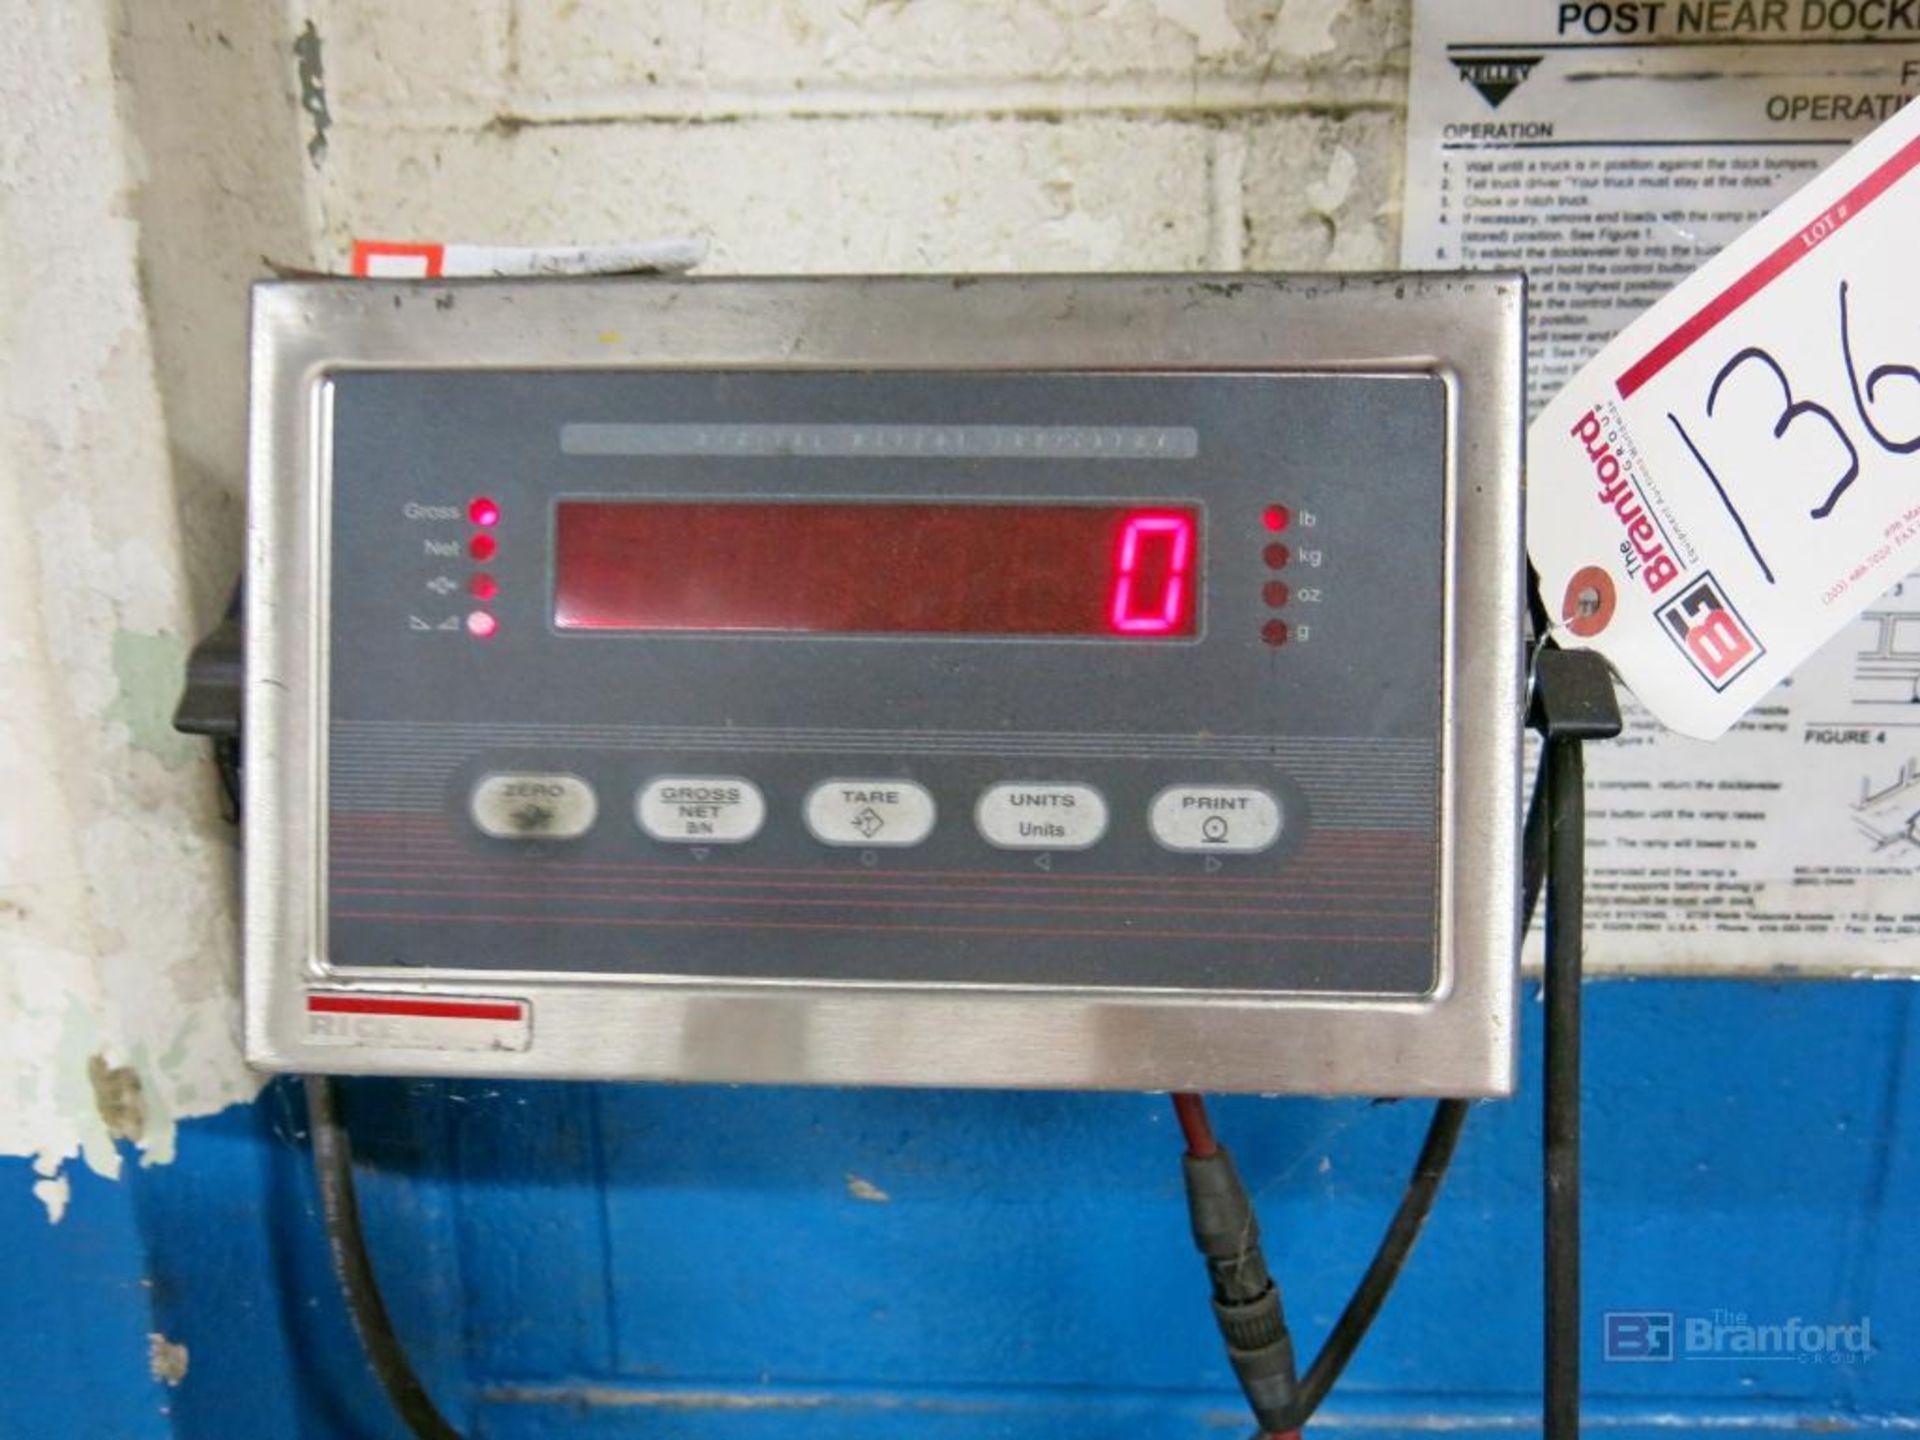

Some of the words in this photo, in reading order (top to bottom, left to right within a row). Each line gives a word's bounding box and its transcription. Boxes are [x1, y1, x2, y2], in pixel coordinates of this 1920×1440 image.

[1558, 3, 1667, 35] POST
[1677, 1, 1787, 33] NEAR
[1801, 0, 1920, 31] DOCK
[1459, 65, 1533, 82] KELLEY
[1766, 93, 1913, 121] OPERATI
[1443, 122, 1554, 139] OPERATION
[1802, 213, 1835, 247] LOT
[1594, 404, 1633, 471] GROUP
[1570, 410, 1679, 594] Branford
[403, 502, 461, 520] Gross
[1299, 510, 1316, 526] lb
[424, 538, 459, 557] Net
[1299, 547, 1322, 567] kg
[1619, 540, 1641, 579] The
[1112, 514, 1190, 632] 0
[1297, 588, 1321, 602] oz
[1296, 625, 1310, 642] g
[1804, 730, 1870, 745] FIGURE
[1876, 730, 1887, 745] 4
[503, 783, 565, 798] ZERO
[660, 786, 742, 801] GROSS
[843, 790, 900, 805] TARE
[1010, 793, 1076, 809] UNITS
[1182, 795, 1250, 811] PRINT
[677, 804, 723, 818] NET
[1018, 820, 1066, 838] Units
